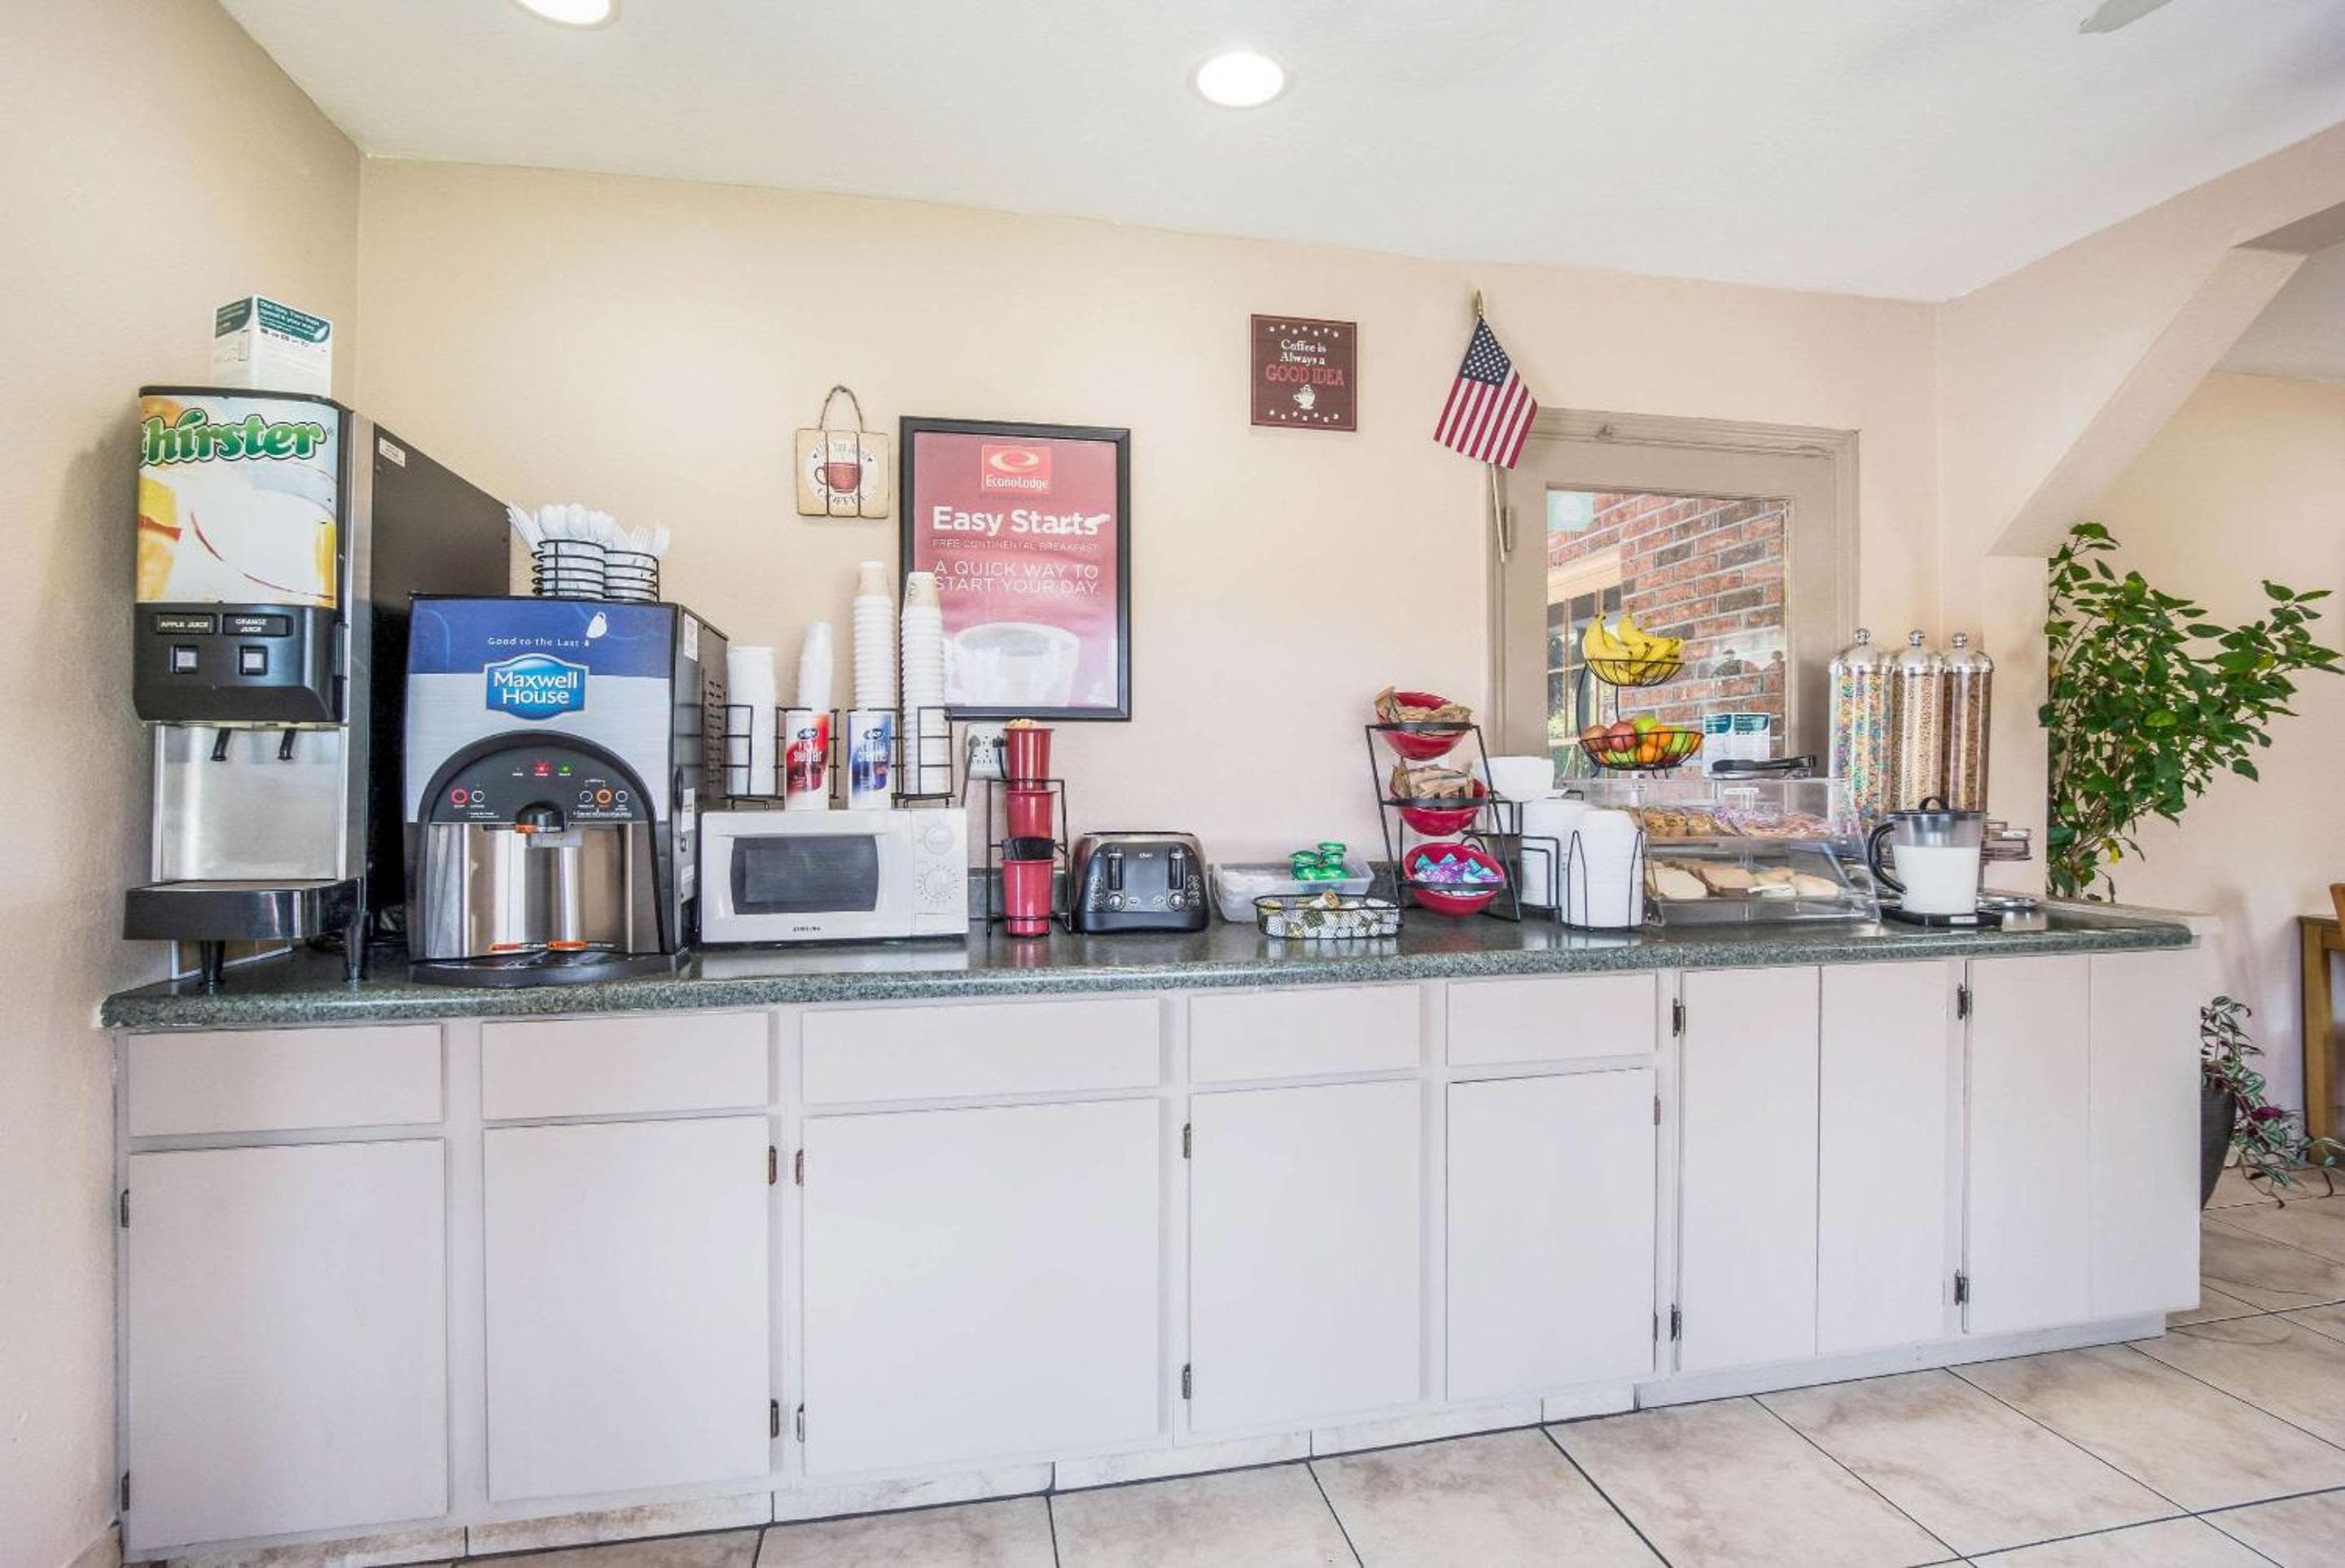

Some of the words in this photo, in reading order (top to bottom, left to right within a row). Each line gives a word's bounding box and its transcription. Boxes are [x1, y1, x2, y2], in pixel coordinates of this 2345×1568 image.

[1281, 339, 1316, 352] Coffee
[1317, 342, 1326, 353] is
[1280, 352, 1317, 366] Always
[1265, 364, 1309, 383] GOOD
[1312, 367, 1344, 386] IDEA
[932, 506, 1004, 537] Easy
[1010, 509, 1111, 536] Starts
[932, 539, 960, 549] FREE
[934, 560, 946, 575] A
[954, 560, 1016, 577] QUICK
[1023, 563, 1066, 578] WAY
[1074, 564, 1098, 580] TO
[936, 576, 994, 593] START
[1002, 578, 1058, 594] YOUR
[487, 637, 516, 646] Good
[535, 637, 553, 646] the
[557, 638, 580, 647] Last
[493, 671, 577, 690] Maxwell
[502, 688, 570, 704] House
